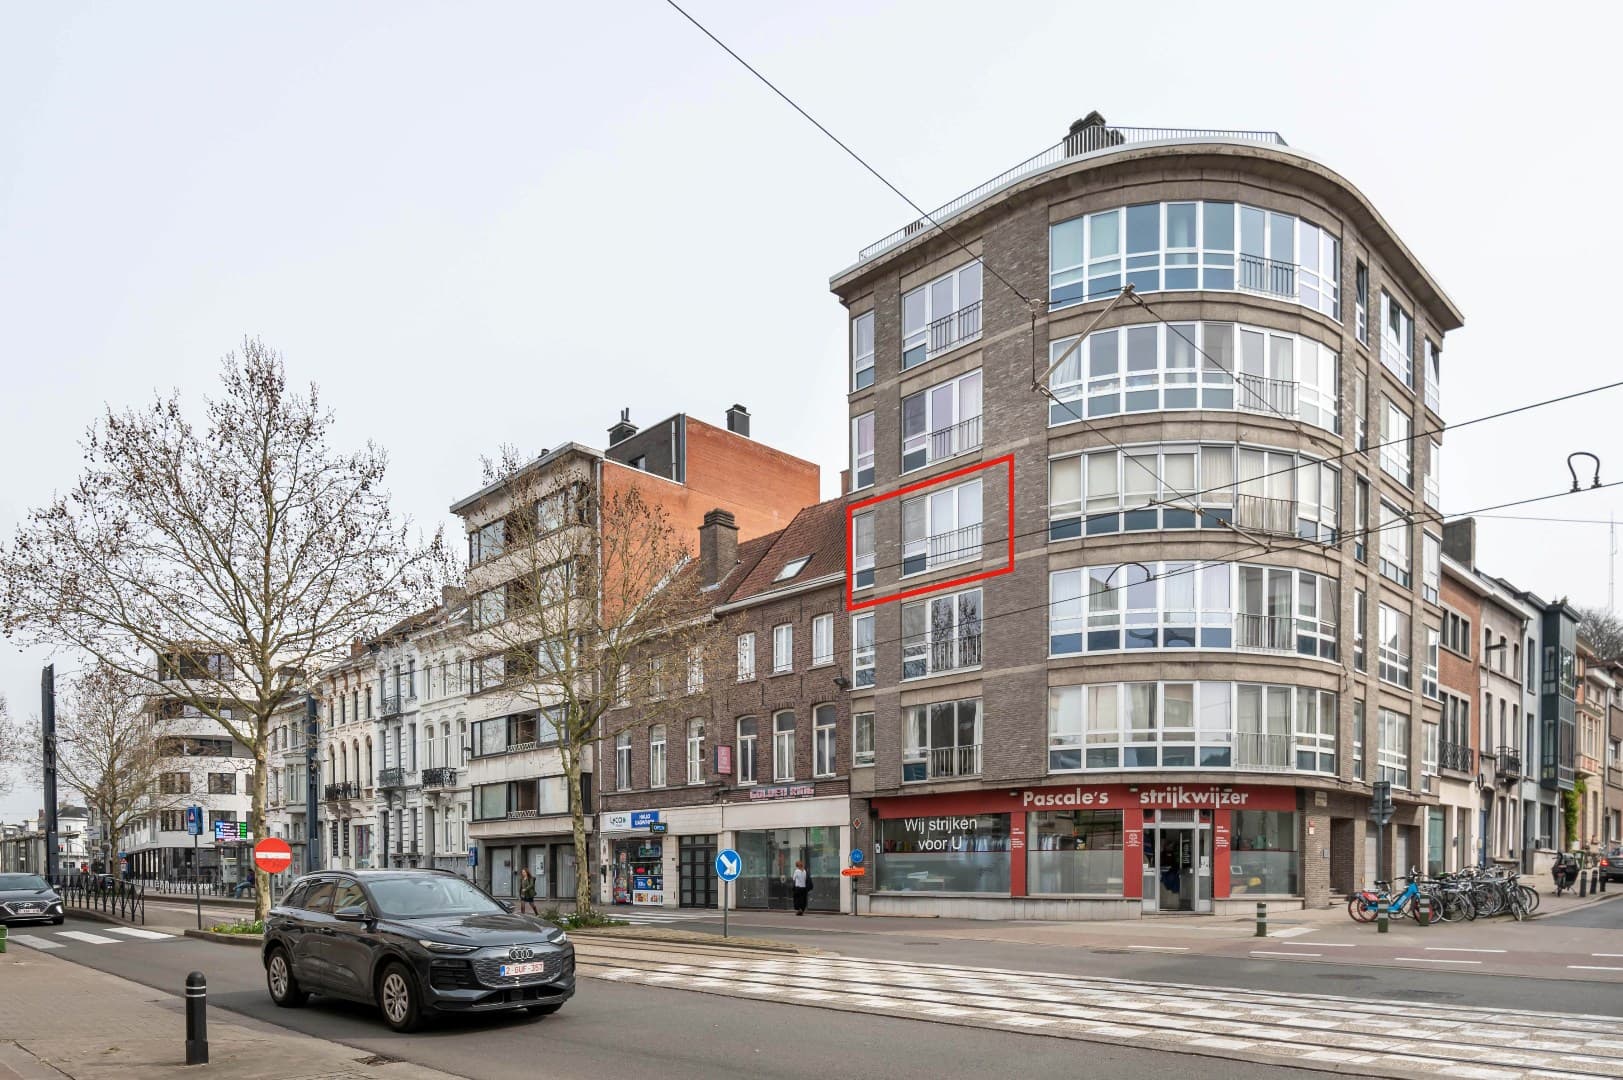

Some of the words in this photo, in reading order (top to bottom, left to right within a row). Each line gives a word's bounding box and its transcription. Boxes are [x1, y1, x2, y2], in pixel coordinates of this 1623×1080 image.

[1023, 788, 1109, 807] Pascale's
[1140, 786, 1249, 808] strijkwijzer
[904, 818, 925, 834] Wij
[928, 816, 977, 834] strijken
[918, 838, 948, 850] voor
[951, 835, 962, 850] U
